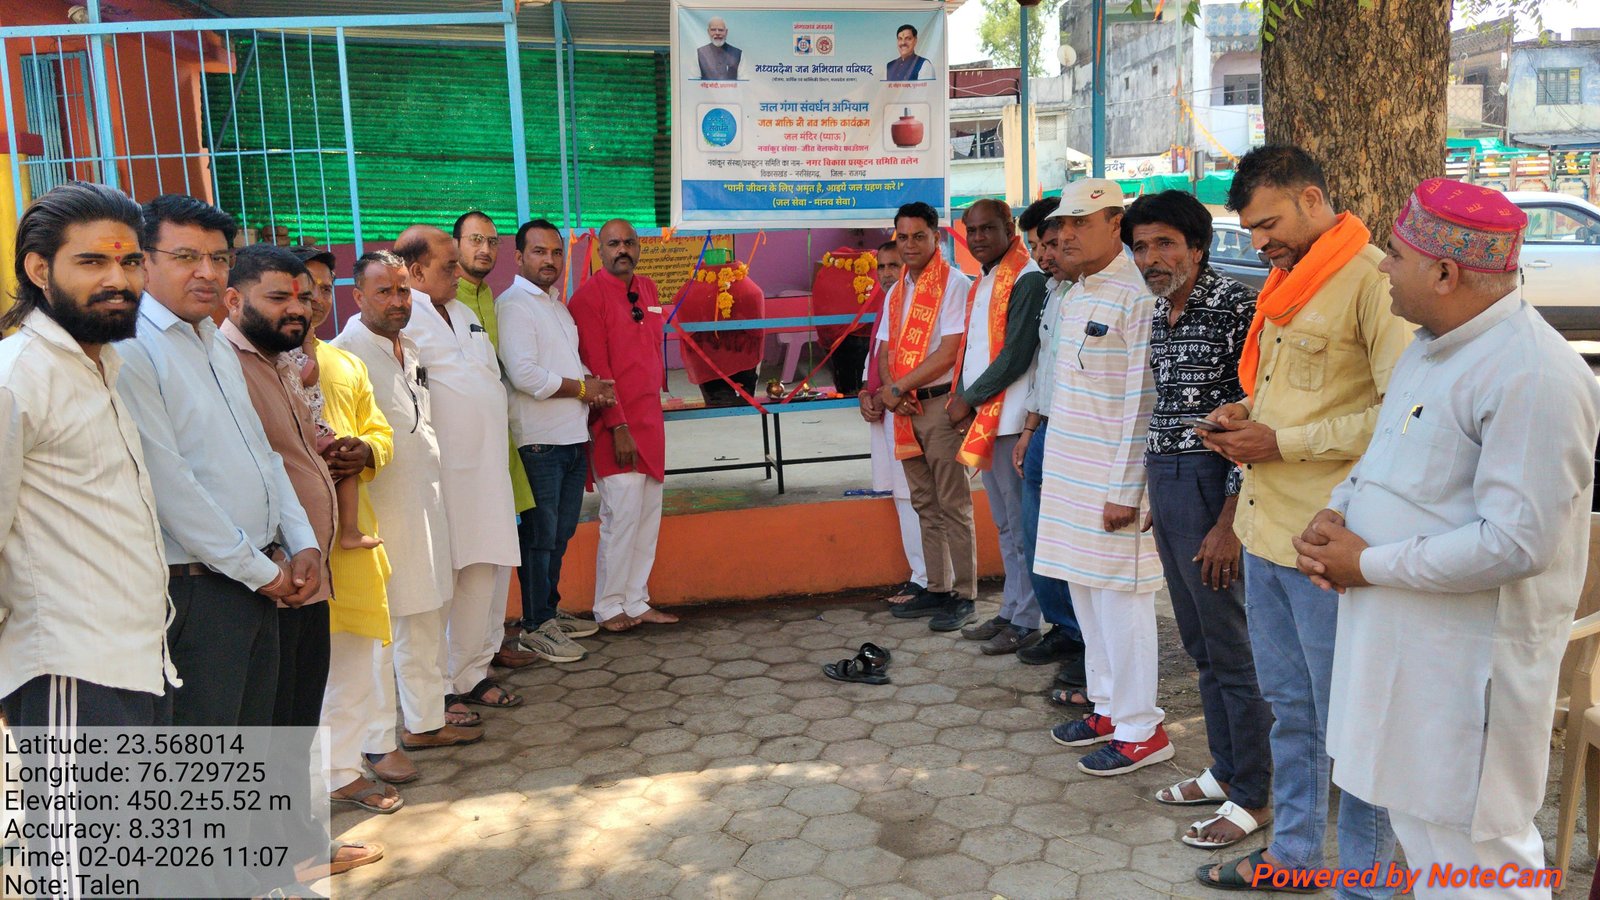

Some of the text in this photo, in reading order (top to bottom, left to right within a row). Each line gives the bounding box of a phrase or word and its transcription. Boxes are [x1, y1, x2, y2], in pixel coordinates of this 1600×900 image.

[755, 63, 792, 74] मध्यप्रदेश
[795, 65, 809, 73] जन
[812, 63, 843, 73] अभियान
[760, 100, 869, 112] जल गंगा संवर्धन अभियान
[758, 119, 772, 127] जल
[784, 133, 797, 141] जल
[800, 131, 817, 140] मंदिर
[823, 158, 846, 166] विकास
[876, 156, 898, 165] समिति
[900, 156, 919, 165] तलेन
[746, 183, 767, 192] जीवन
[769, 182, 777, 192] के
[779, 182, 794, 194] लिए
[796, 184, 814, 194] अमृत
[848, 183, 862, 192] जल
[792, 196, 806, 206] सेवा
[814, 198, 834, 206] मानव
[899, 304, 935, 368] जय श्री राम
